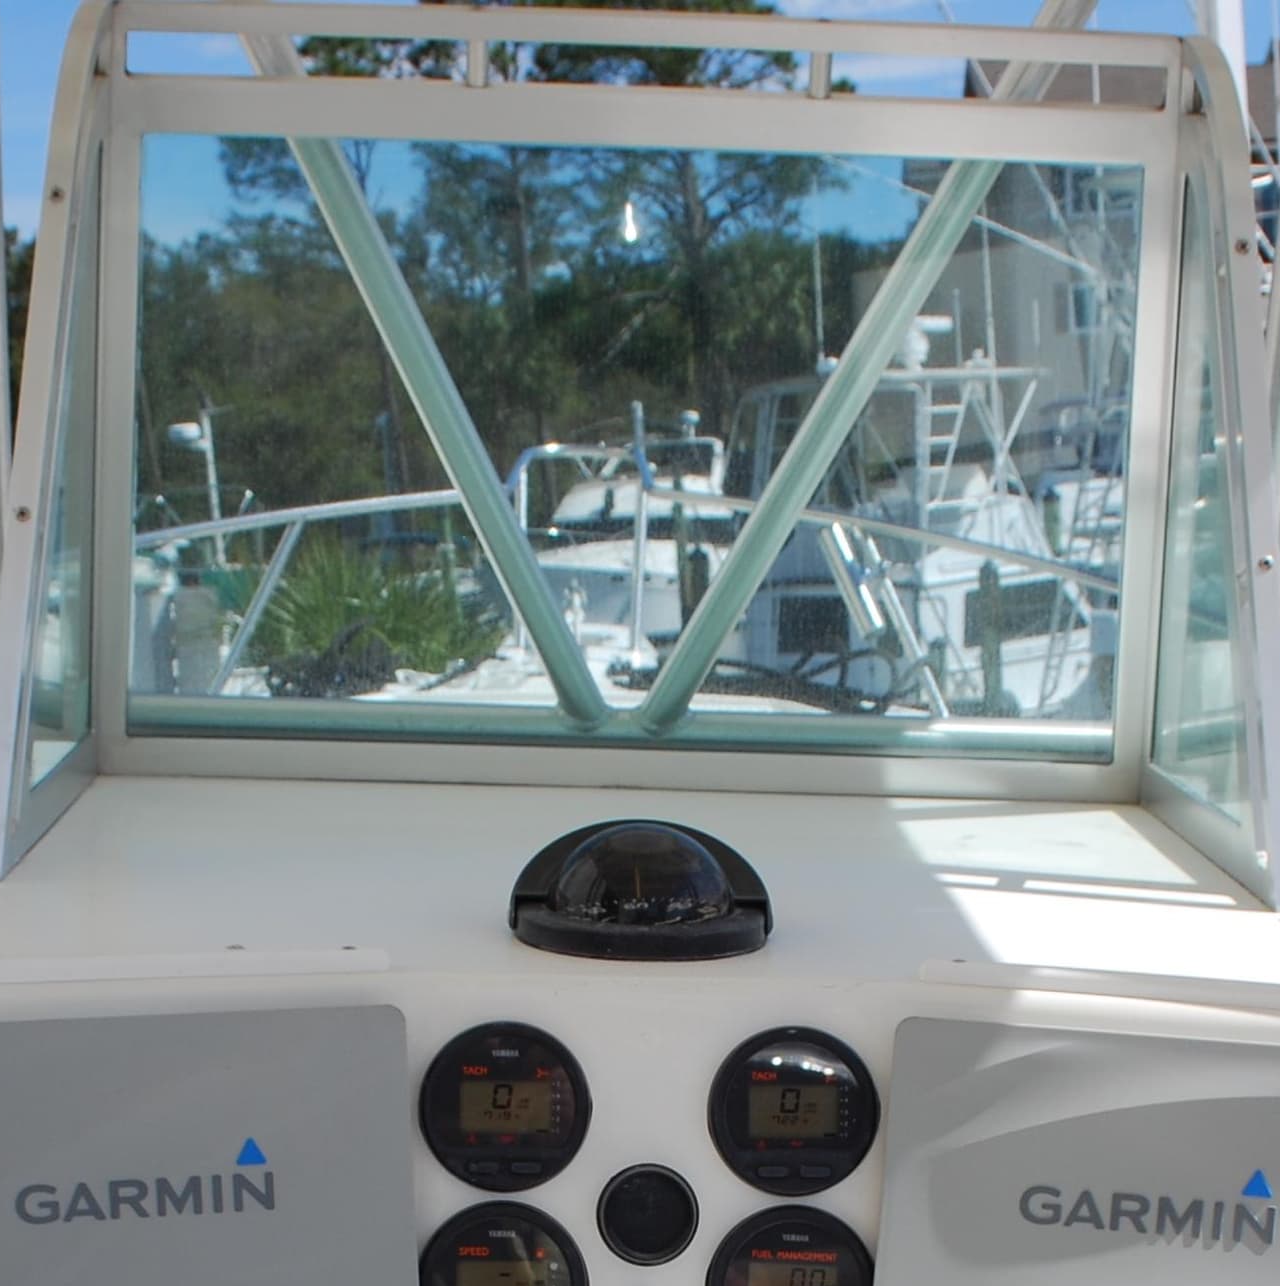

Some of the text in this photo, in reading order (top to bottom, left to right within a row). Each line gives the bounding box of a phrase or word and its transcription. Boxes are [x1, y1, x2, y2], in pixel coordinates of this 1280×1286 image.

[463, 1066, 488, 1076] TACH
[751, 1071, 778, 1081] TACH
[492, 1084, 513, 1110] 0
[780, 1088, 801, 1113] 0
[14, 1172, 276, 1225] GARMIN
[1018, 1184, 1278, 1246] GARMIN
[458, 1246, 490, 1256] SPEED
[751, 1249, 839, 1263] FUEL MANAGEMENT
